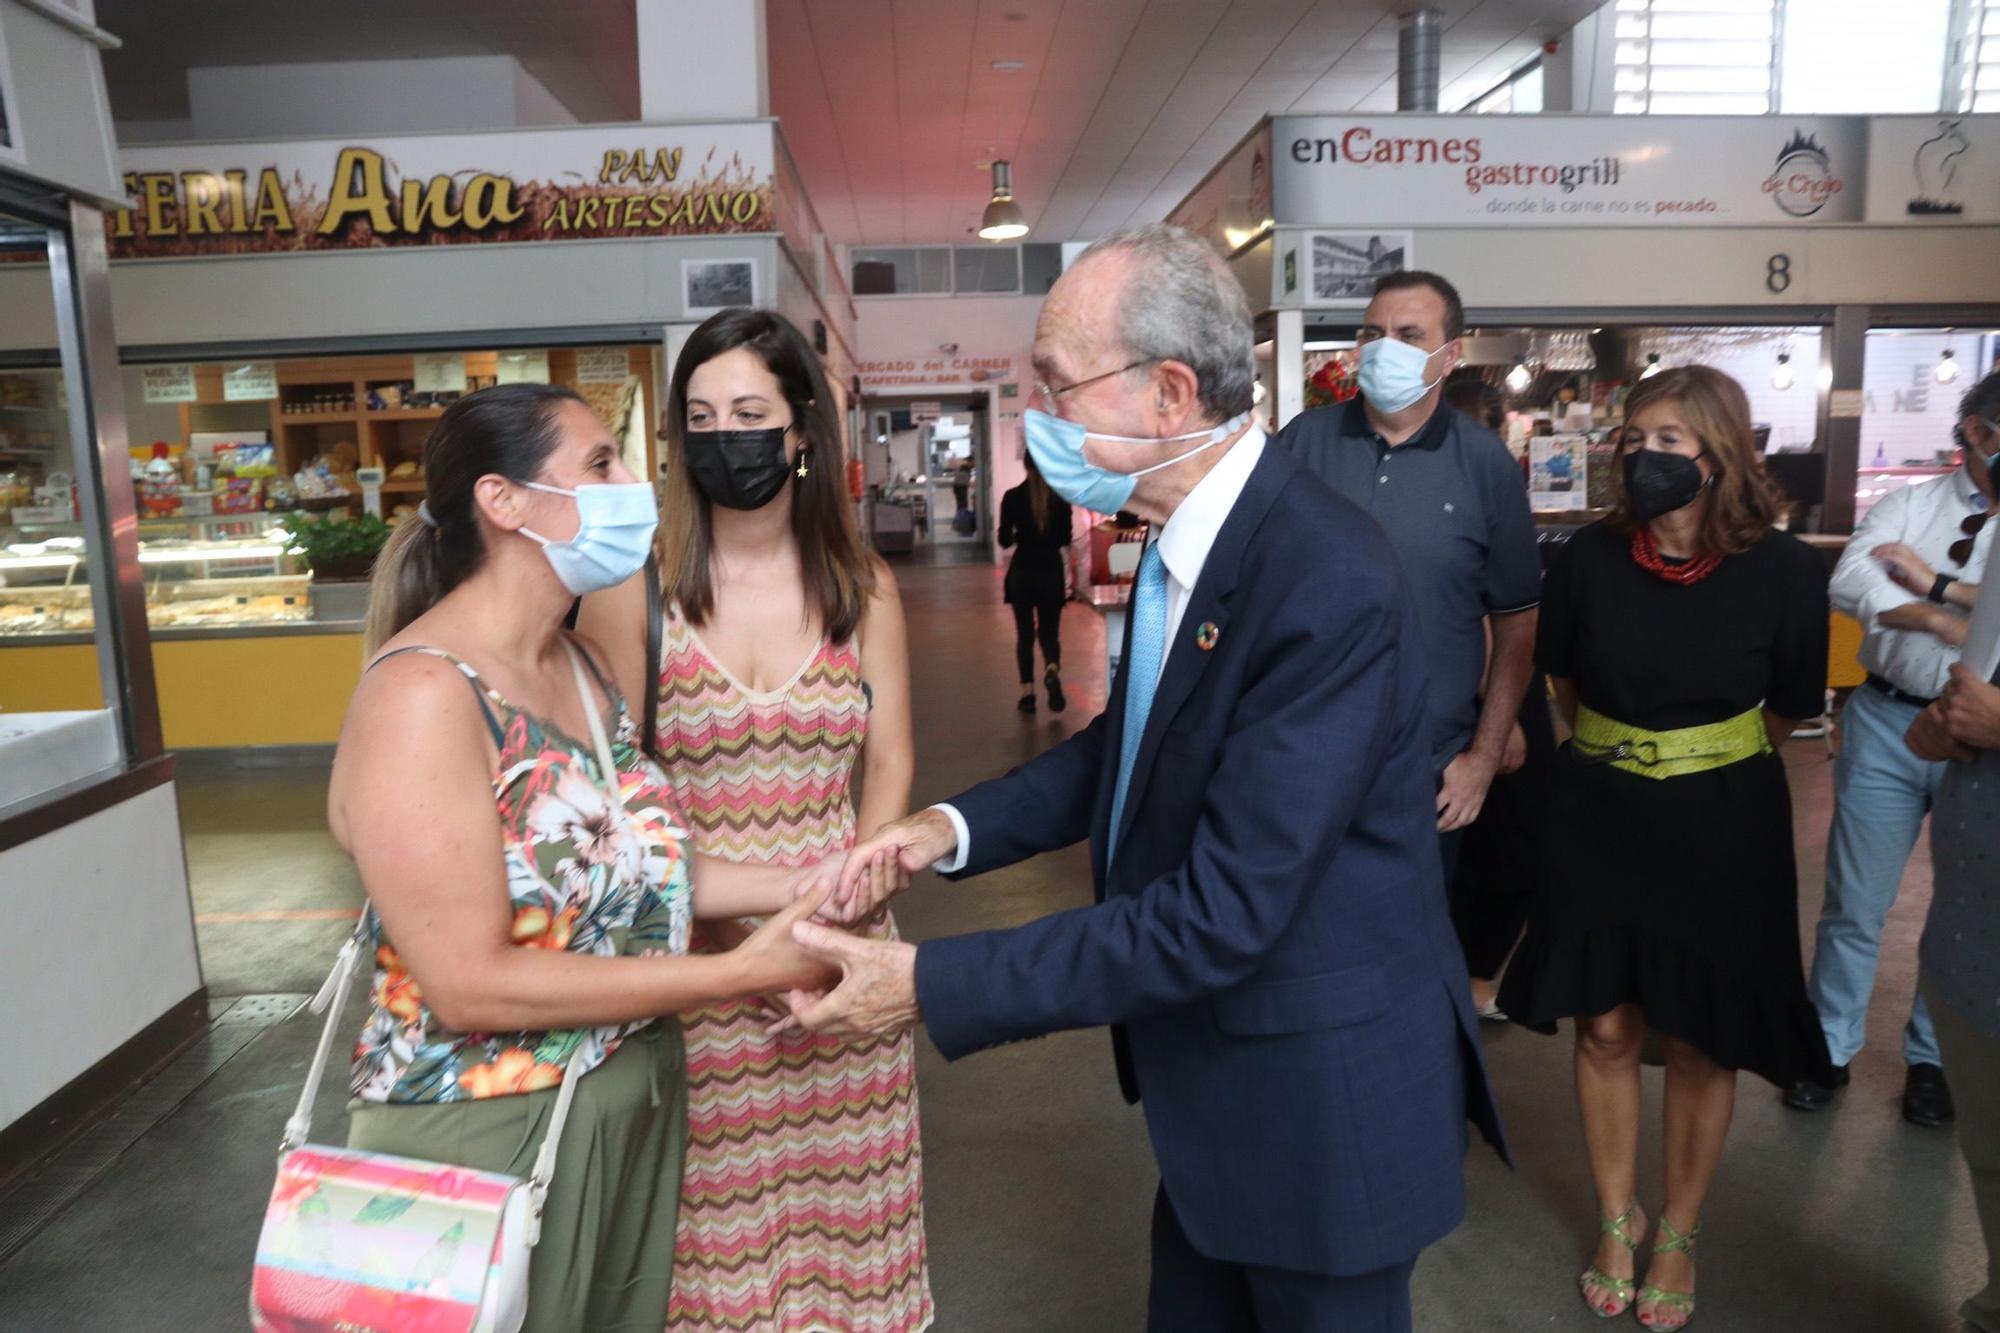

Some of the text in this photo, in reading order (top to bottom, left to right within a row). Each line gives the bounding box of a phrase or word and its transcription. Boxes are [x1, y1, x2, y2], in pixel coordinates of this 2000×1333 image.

[1291, 126, 1481, 164] enCarnes
[600, 146, 683, 184] PAN
[1465, 158, 1620, 194] gastrogrill
[317, 146, 525, 235] Ana
[542, 190, 760, 231] ARTESANO
[1767, 252, 1791, 294] 8
